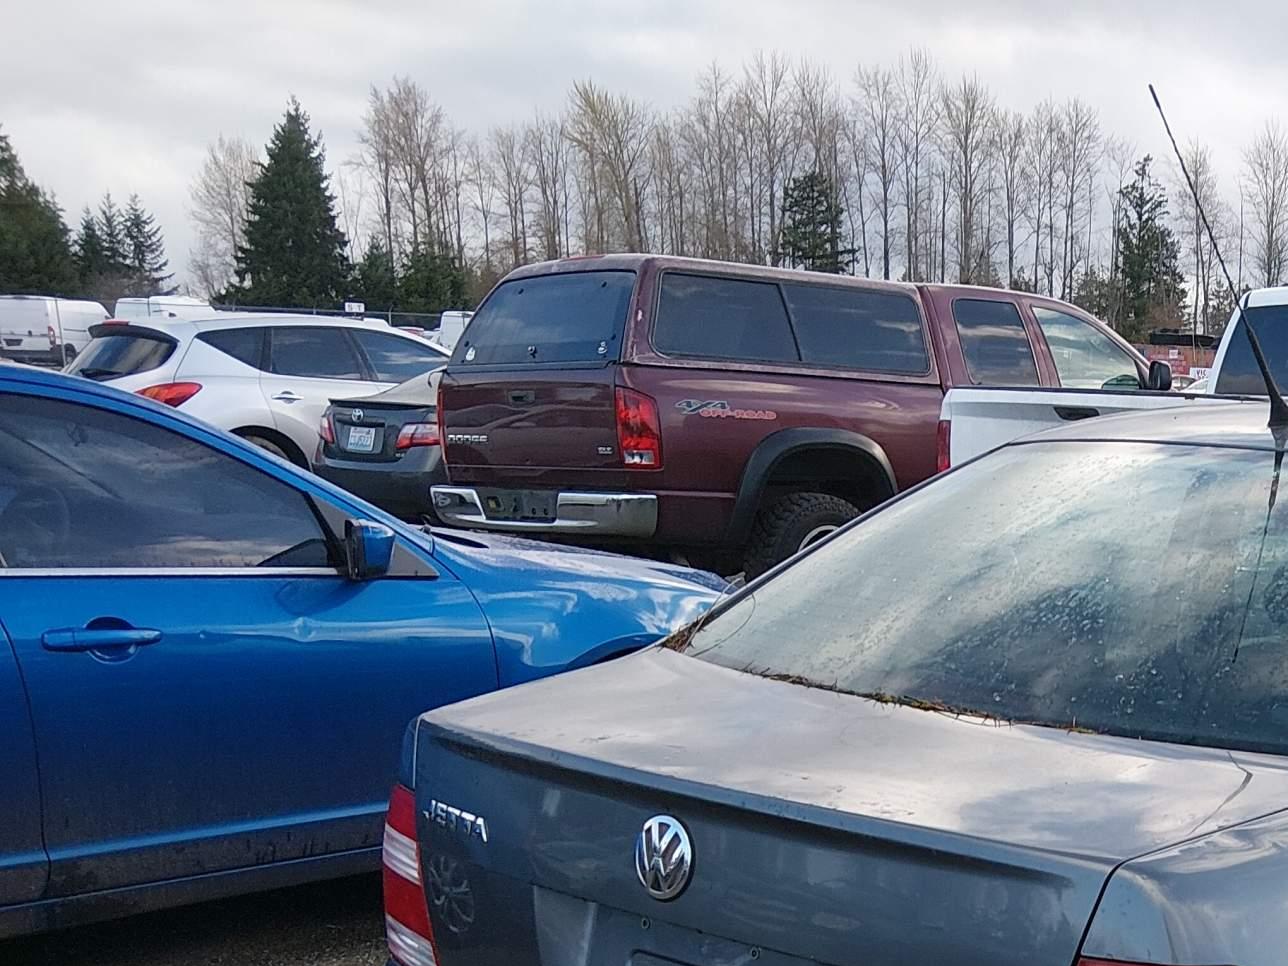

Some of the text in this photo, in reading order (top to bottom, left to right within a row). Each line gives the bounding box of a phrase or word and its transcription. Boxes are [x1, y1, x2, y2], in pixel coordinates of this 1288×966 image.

[699, 408, 777, 420] OFF-ROAD
[447, 434, 488, 444] DODGE
[422, 799, 489, 844] JETTA
